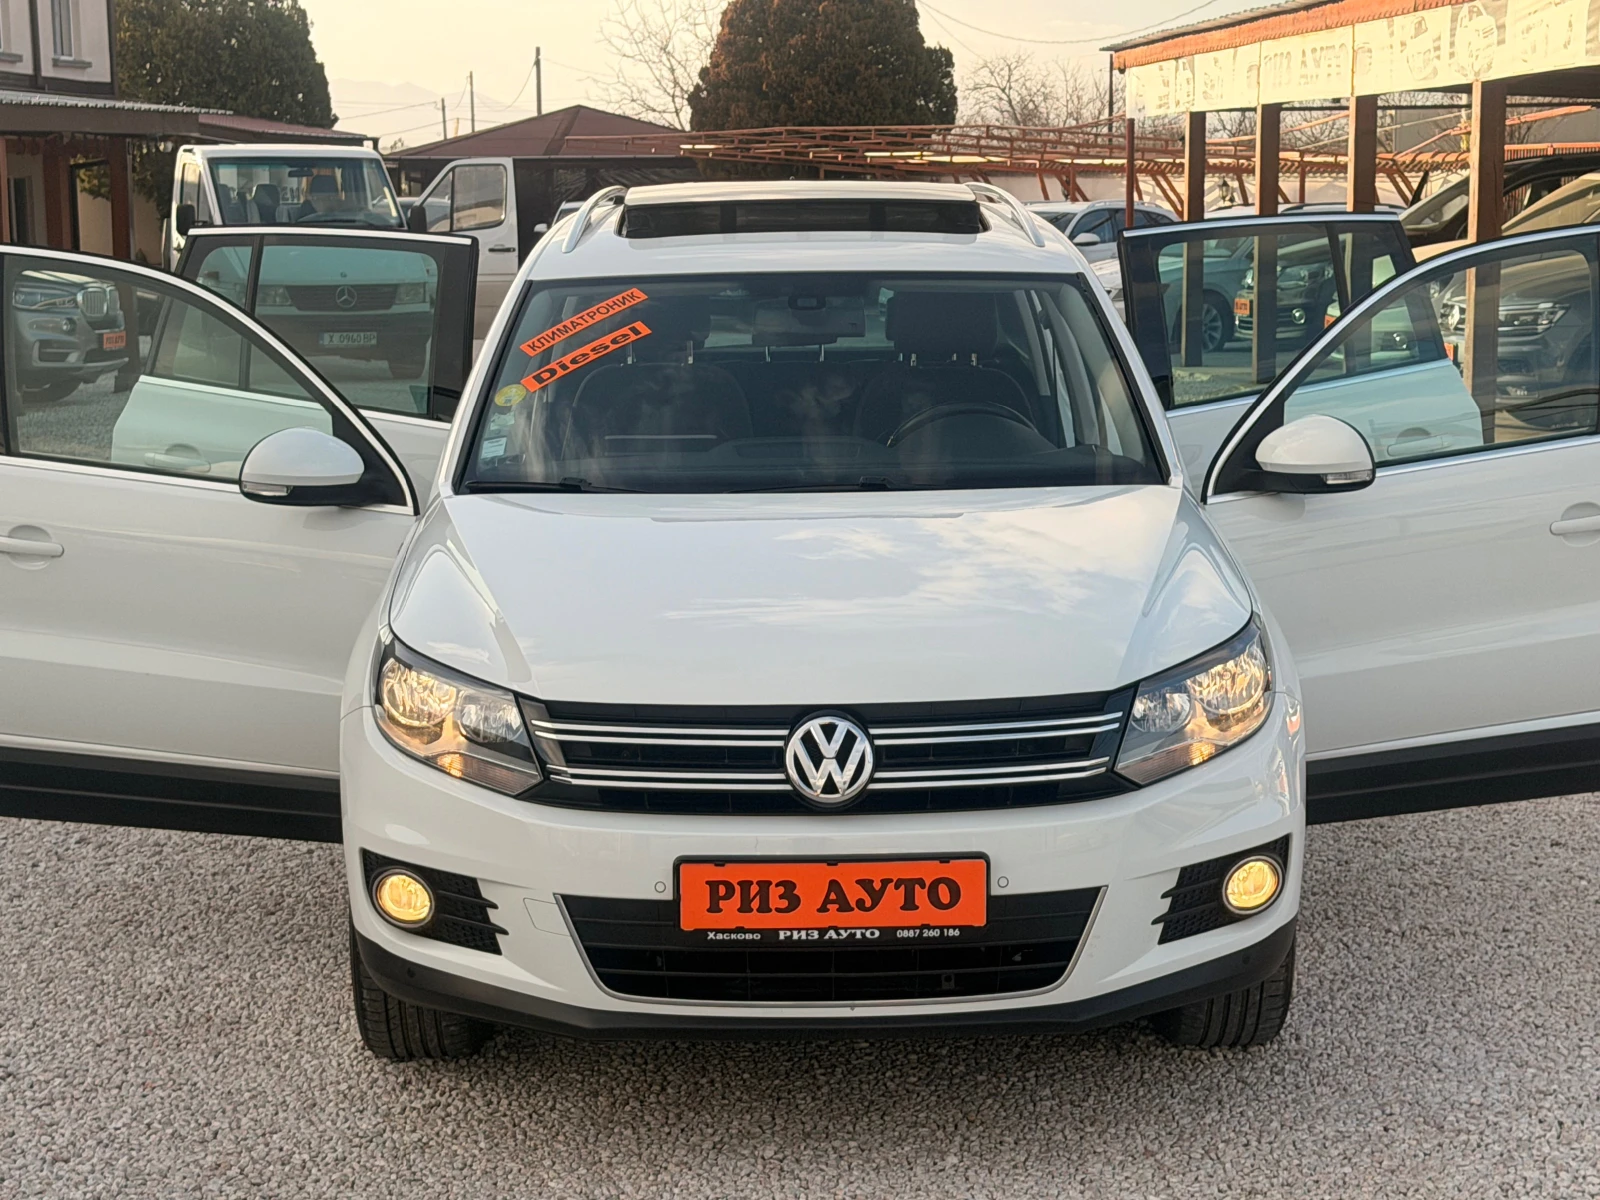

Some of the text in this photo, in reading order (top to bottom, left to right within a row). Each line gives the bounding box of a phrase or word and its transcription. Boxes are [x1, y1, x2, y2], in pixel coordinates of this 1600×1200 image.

[527, 291, 642, 352] КЛИМАТРОНИК
[532, 325, 642, 386] Diesel
[705, 877, 962, 914] РИЗ АУТО
[707, 928, 961, 940] Хасково РИЗ АУТО 0887 260 186
